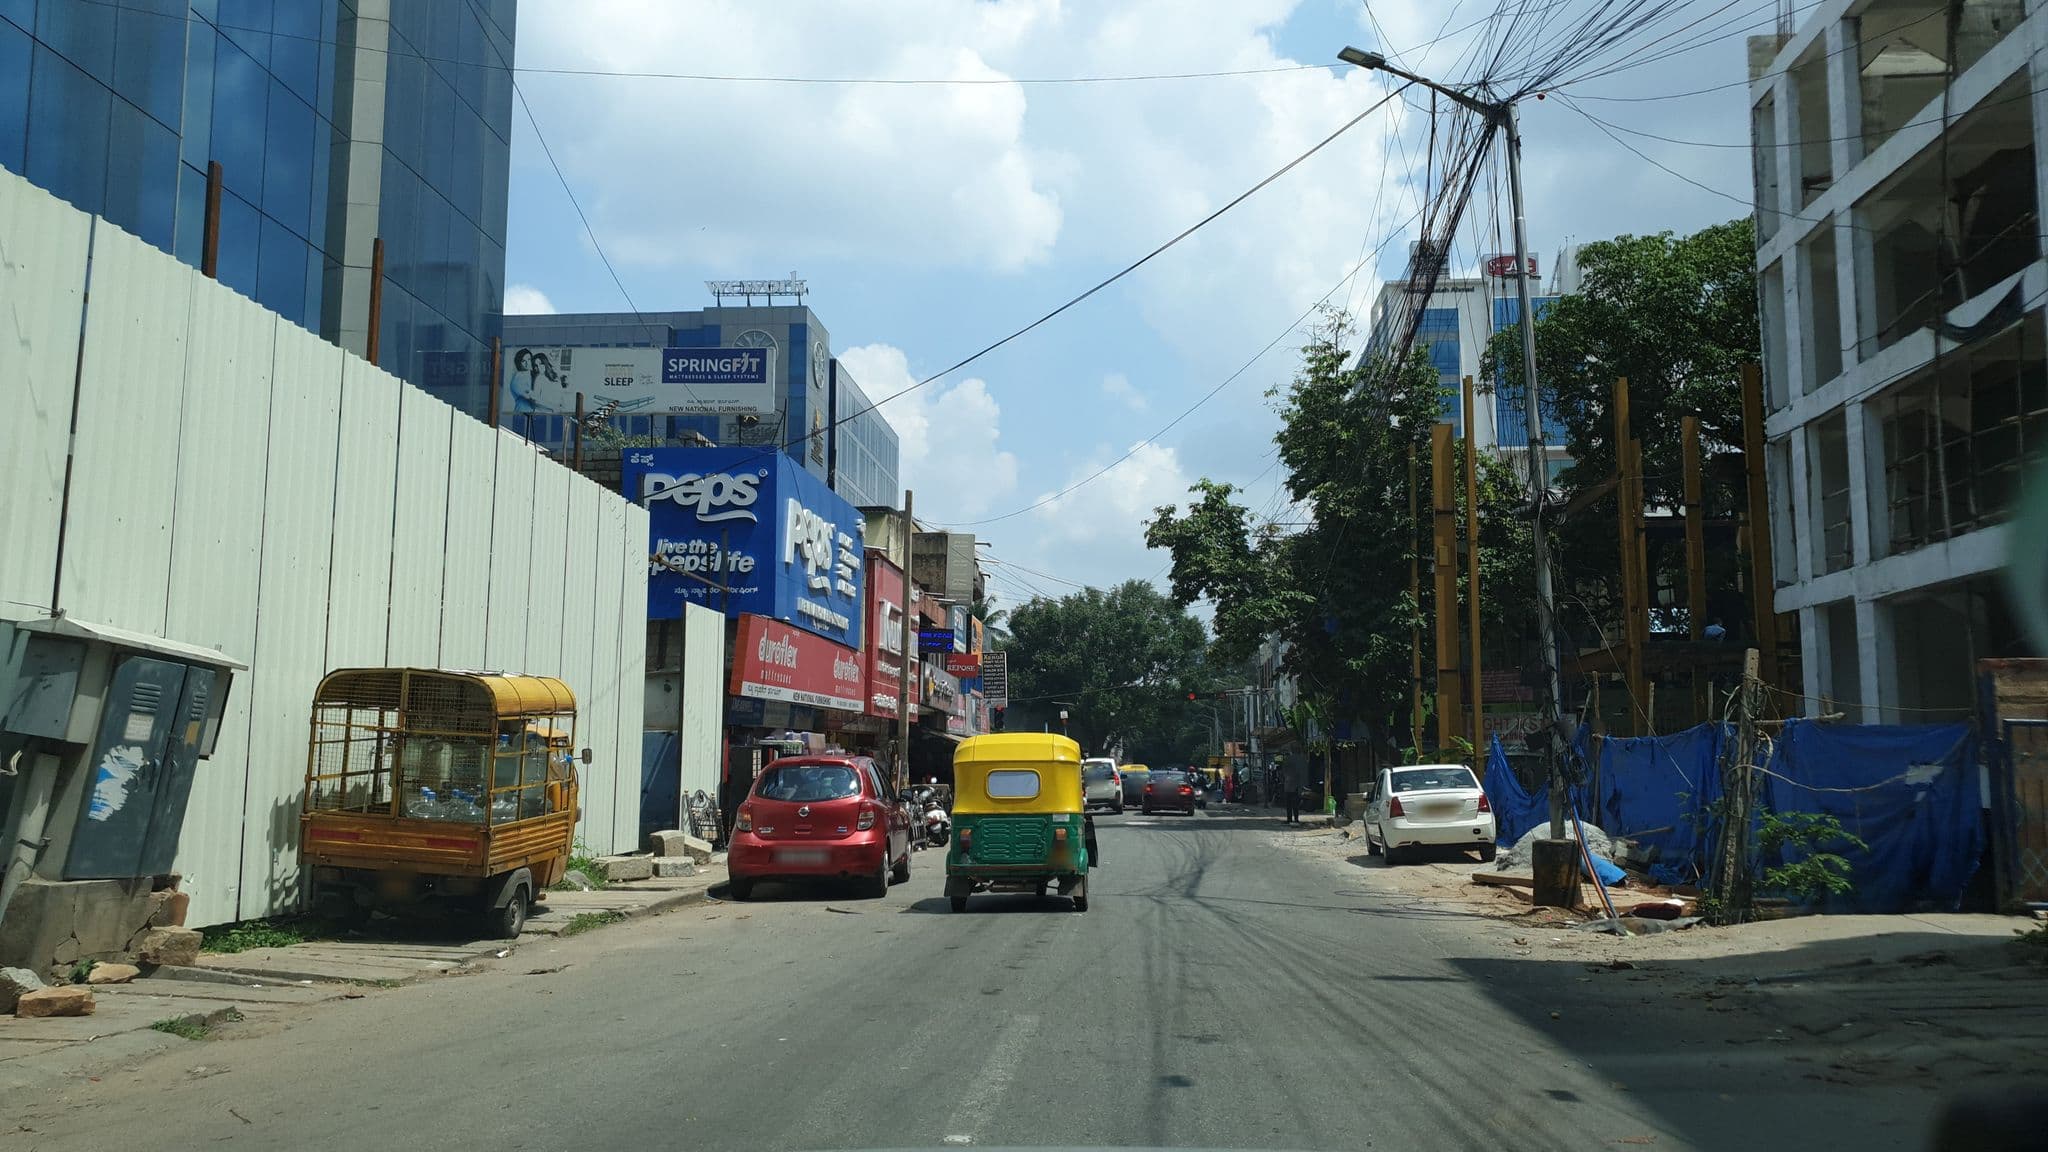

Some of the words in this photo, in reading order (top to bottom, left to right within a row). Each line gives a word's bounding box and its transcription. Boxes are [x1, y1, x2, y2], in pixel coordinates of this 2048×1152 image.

[604, 377, 634, 387] SLEEP
[656, 538, 688, 554] live
[689, 538, 718, 554] the
[758, 627, 798, 669] duroflex
[946, 664, 976, 672] REPOSE
